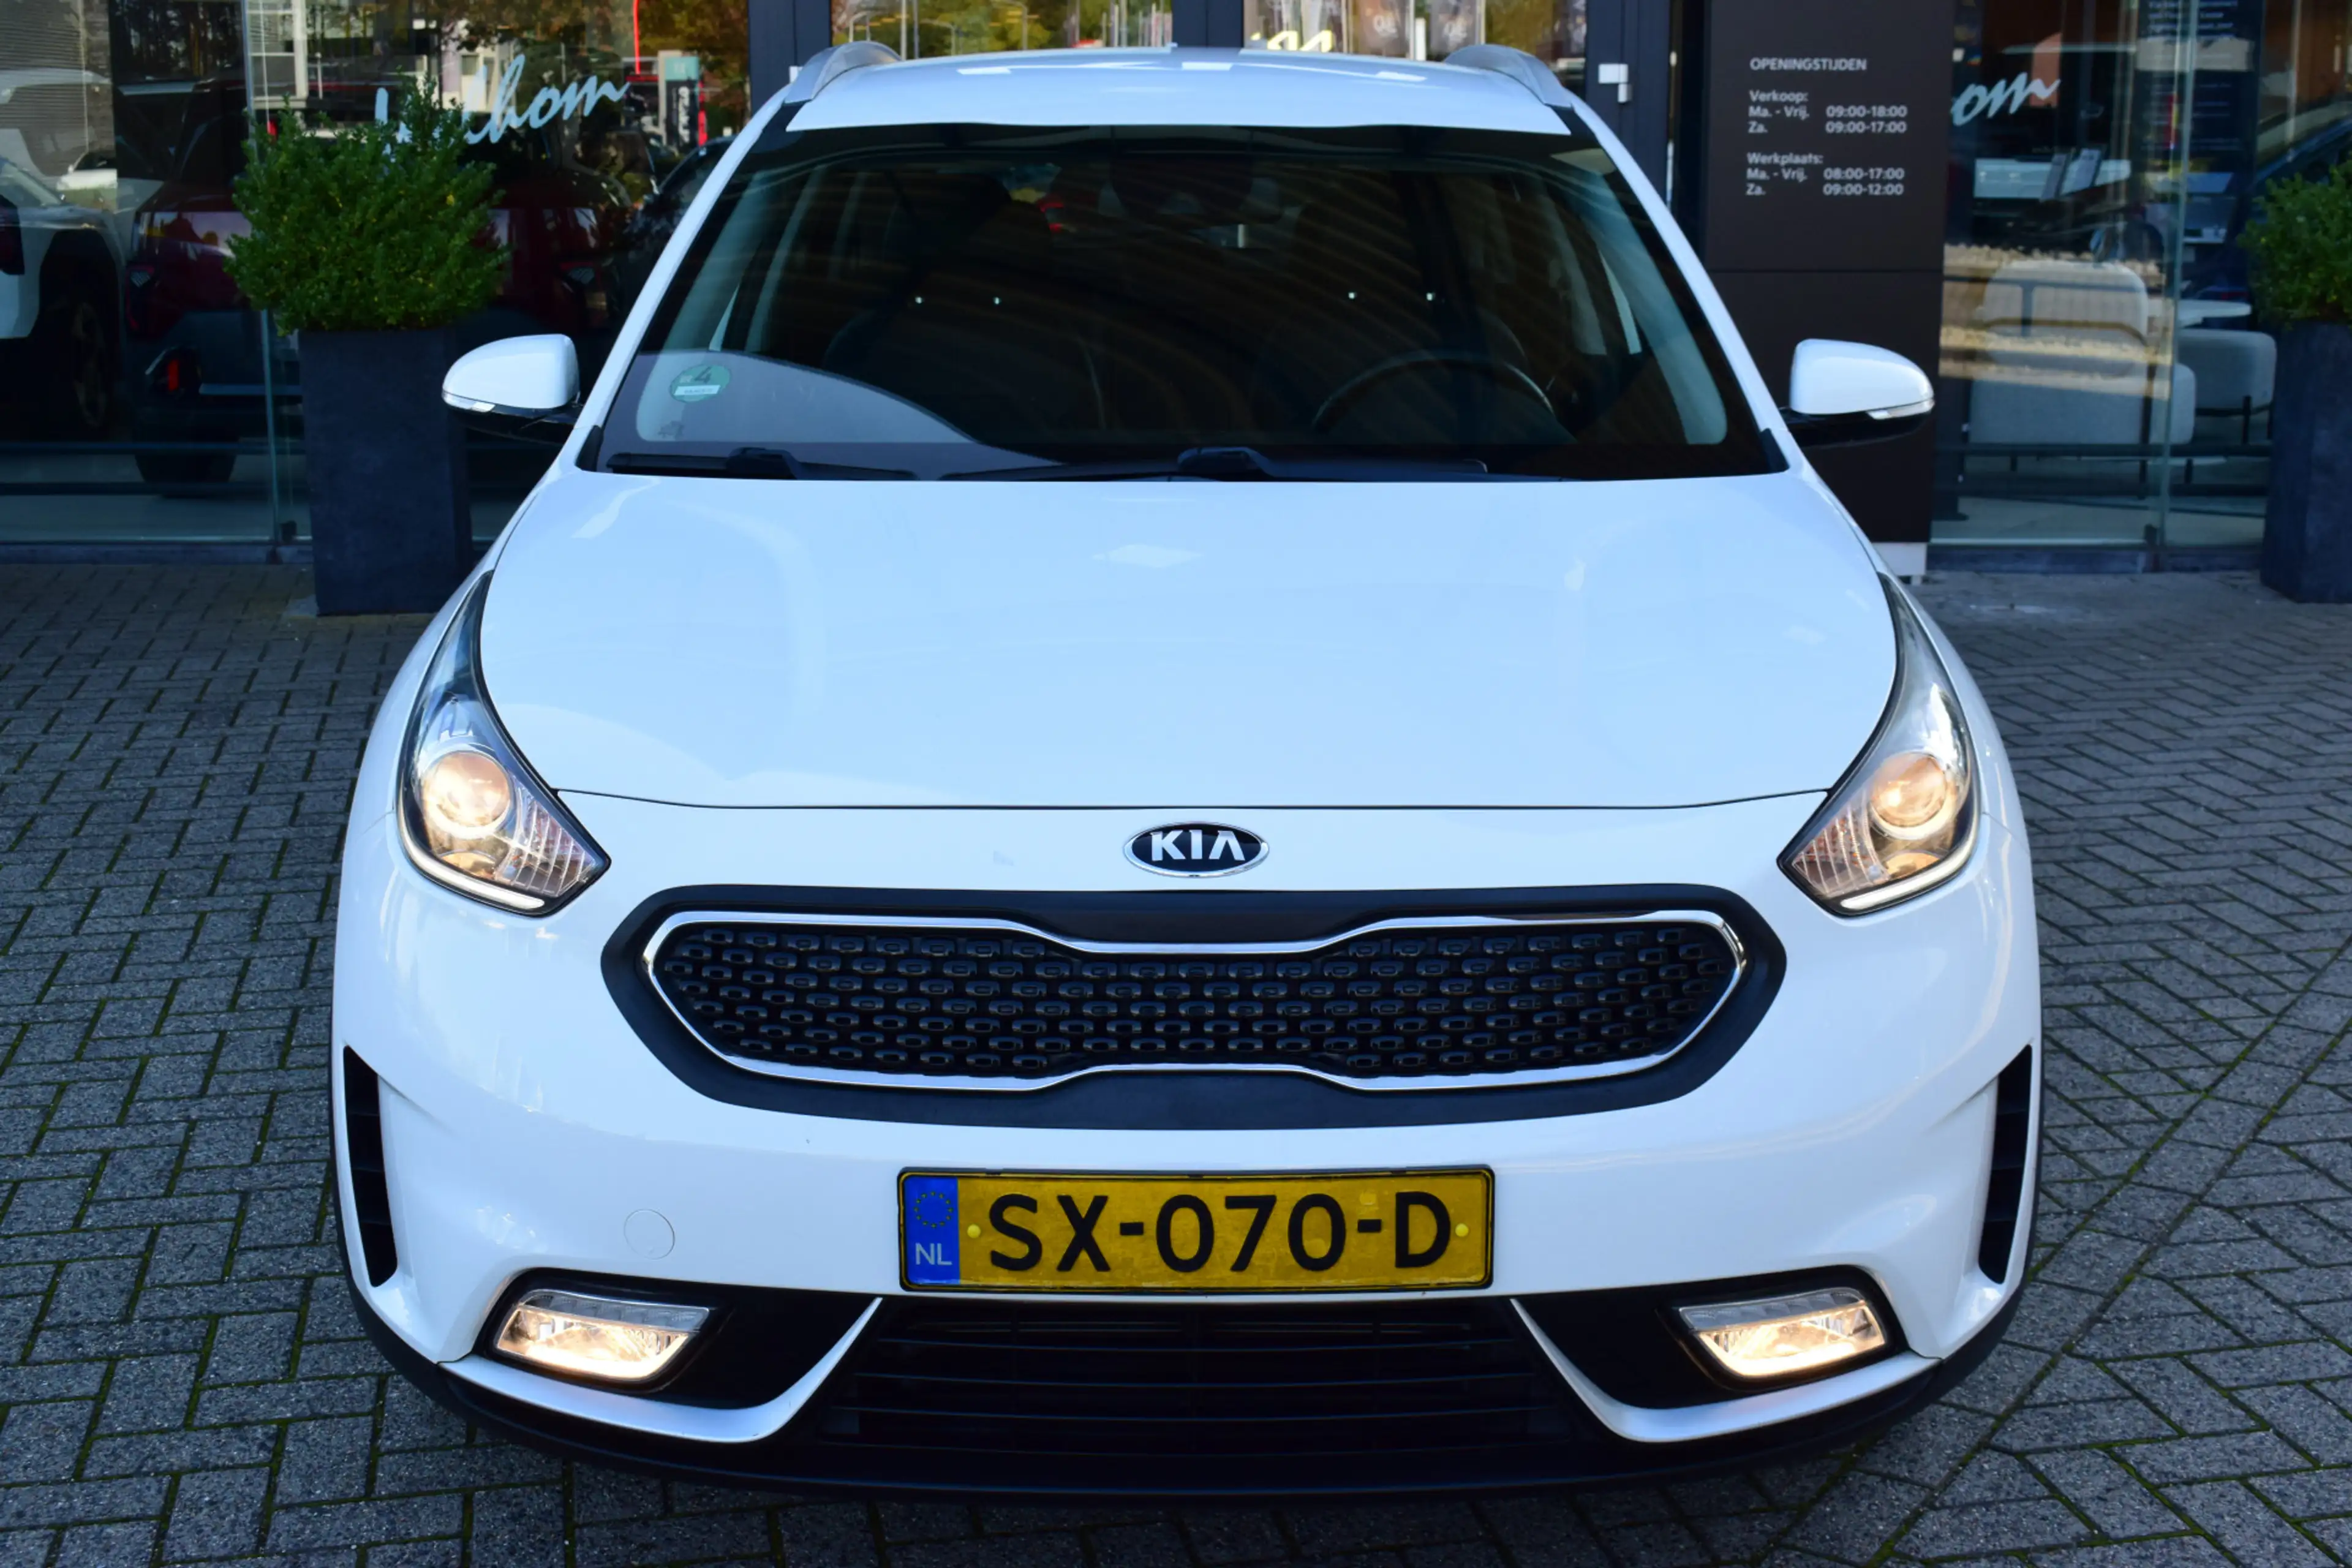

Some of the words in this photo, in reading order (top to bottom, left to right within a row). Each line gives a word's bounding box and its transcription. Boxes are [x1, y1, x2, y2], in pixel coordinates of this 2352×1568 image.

[1749, 58, 1867, 70] OPENINGSTIJDEN
[1749, 89, 1808, 104] Verkoop:
[1748, 106, 1773, 118] Ma.
[1783, 106, 1809, 120] Vrij.
[1826, 105, 1907, 118] 09:00-18:00
[1748, 121, 1768, 133] Za.
[1825, 121, 1907, 133] 09:00-17:00
[1746, 153, 1823, 166] Werkplaats:
[1746, 168, 1770, 179] Ma.
[1781, 168, 1807, 183] Vrij.
[1823, 168, 1905, 179] 08:00-17:00
[1746, 184, 1766, 195] Za.
[1822, 184, 1904, 195] 09:00-12:00
[1150, 829, 1246, 862] KIA
[988, 1191, 1452, 1273] SX-070-D
[914, 1242, 953, 1266] NL
